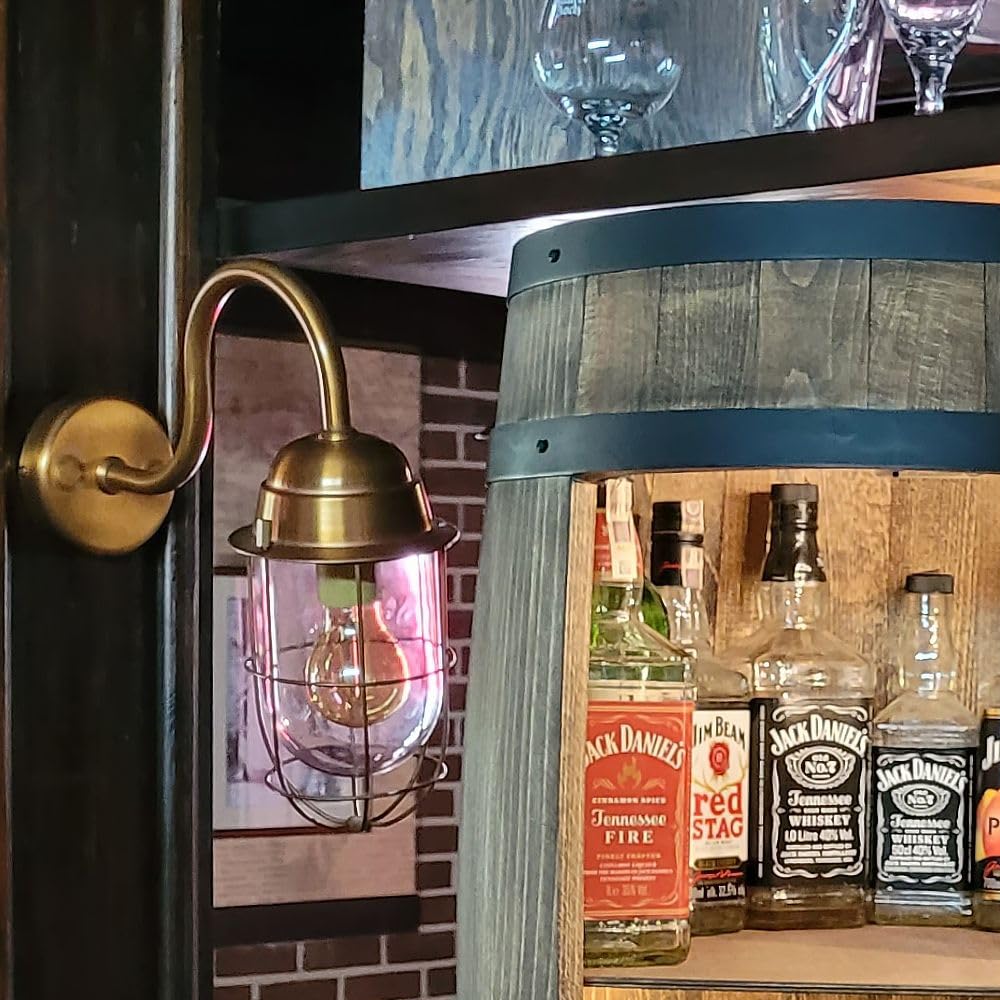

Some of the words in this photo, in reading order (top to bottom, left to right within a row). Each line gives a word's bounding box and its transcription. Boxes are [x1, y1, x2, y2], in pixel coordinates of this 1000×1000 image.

[620, 724, 686, 770] DANIEL'S
[769, 720, 810, 756] JACK
[810, 713, 872, 758] DANIEL'S
[876, 763, 913, 792] JACK
[694, 783, 742, 816] red
[591, 809, 667, 827] Tennessee
[693, 817, 743, 840] STAG
[788, 814, 851, 827] WHISKEY
[605, 830, 654, 844] FIRE
